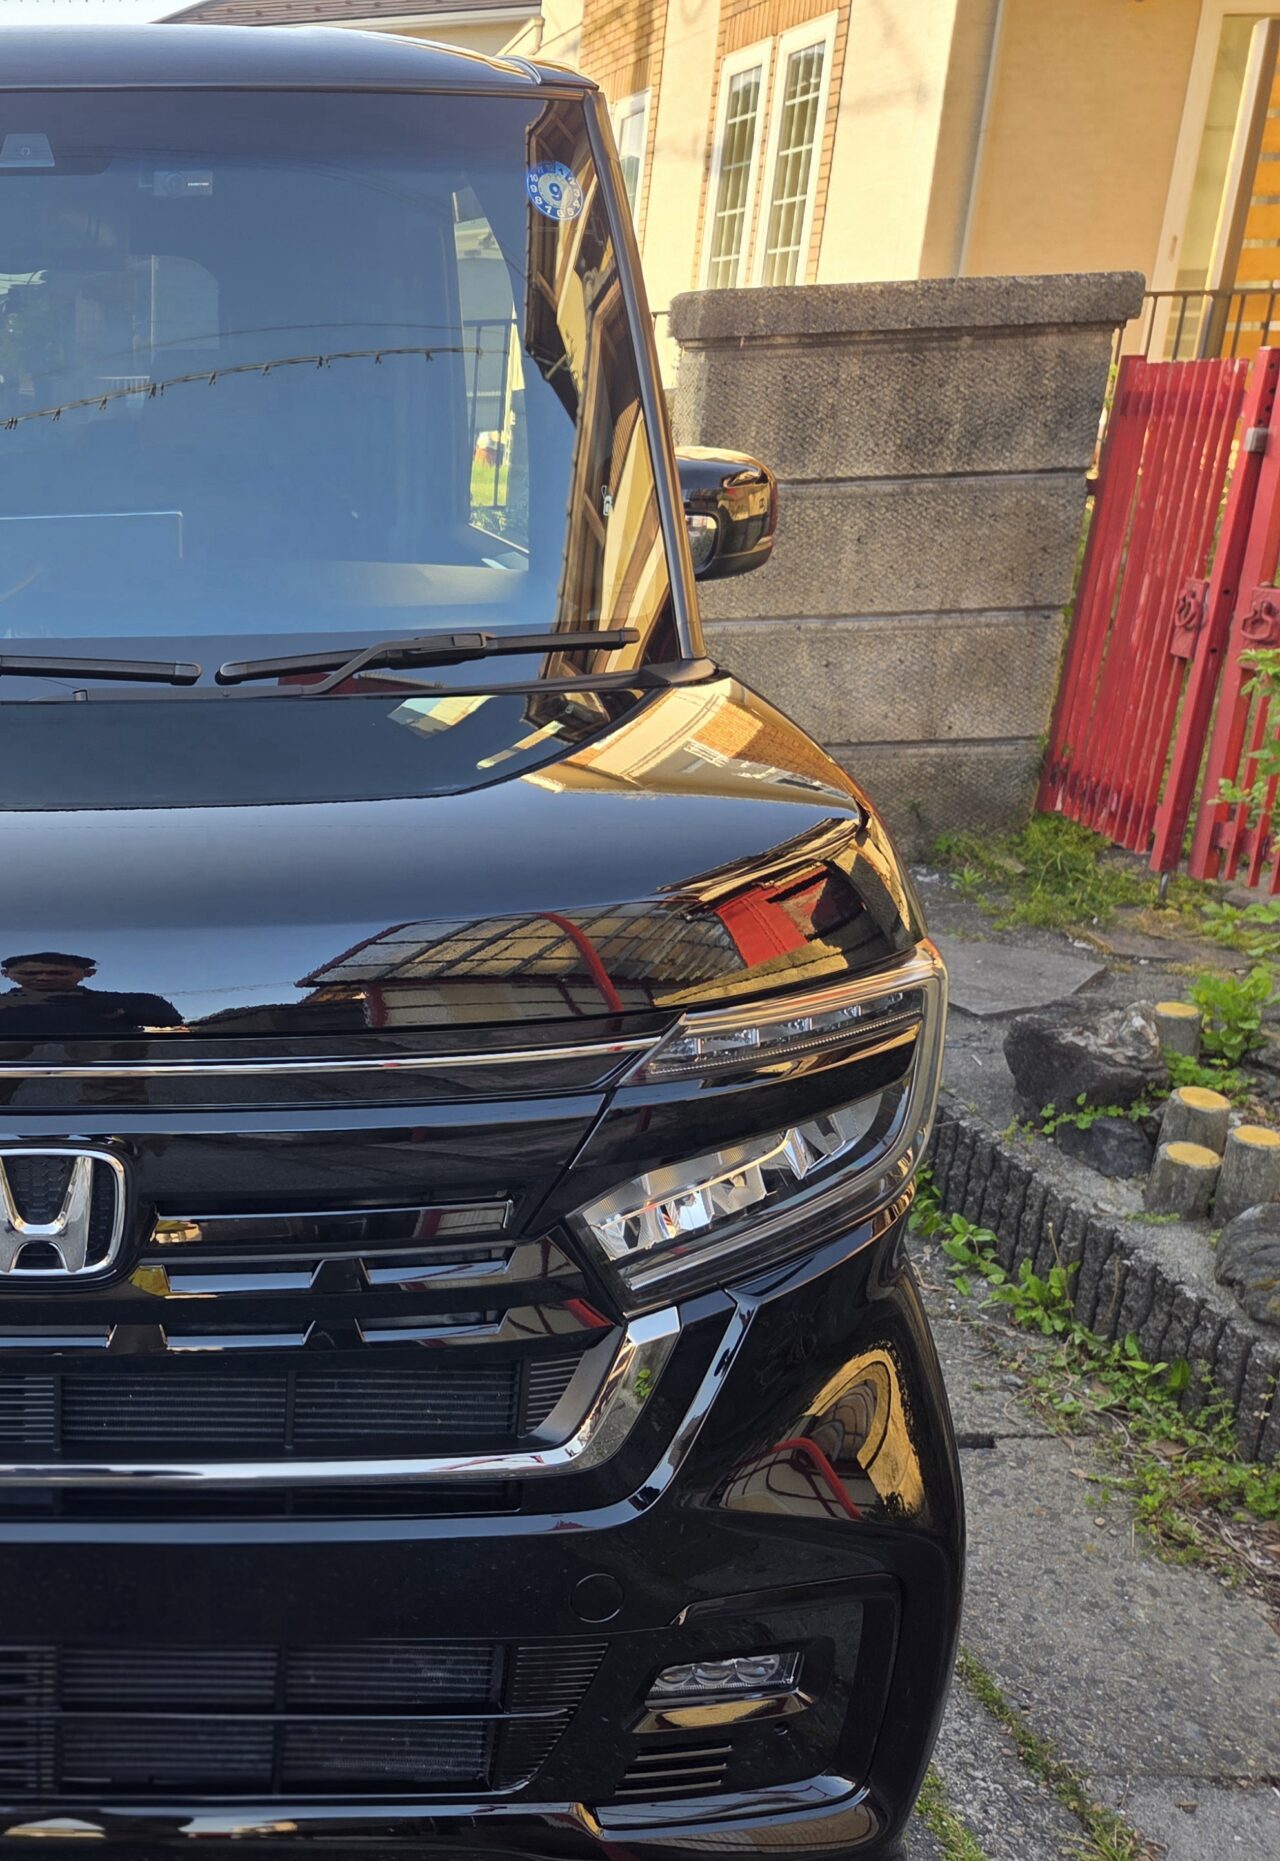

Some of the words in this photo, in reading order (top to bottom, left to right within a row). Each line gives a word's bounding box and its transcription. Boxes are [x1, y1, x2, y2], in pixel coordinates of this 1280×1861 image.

[529, 174, 539, 182] 10
[530, 184, 537, 193] 9
[549, 183, 562, 201] 9
[535, 196, 543, 204] 8
[544, 205, 552, 214] 7
